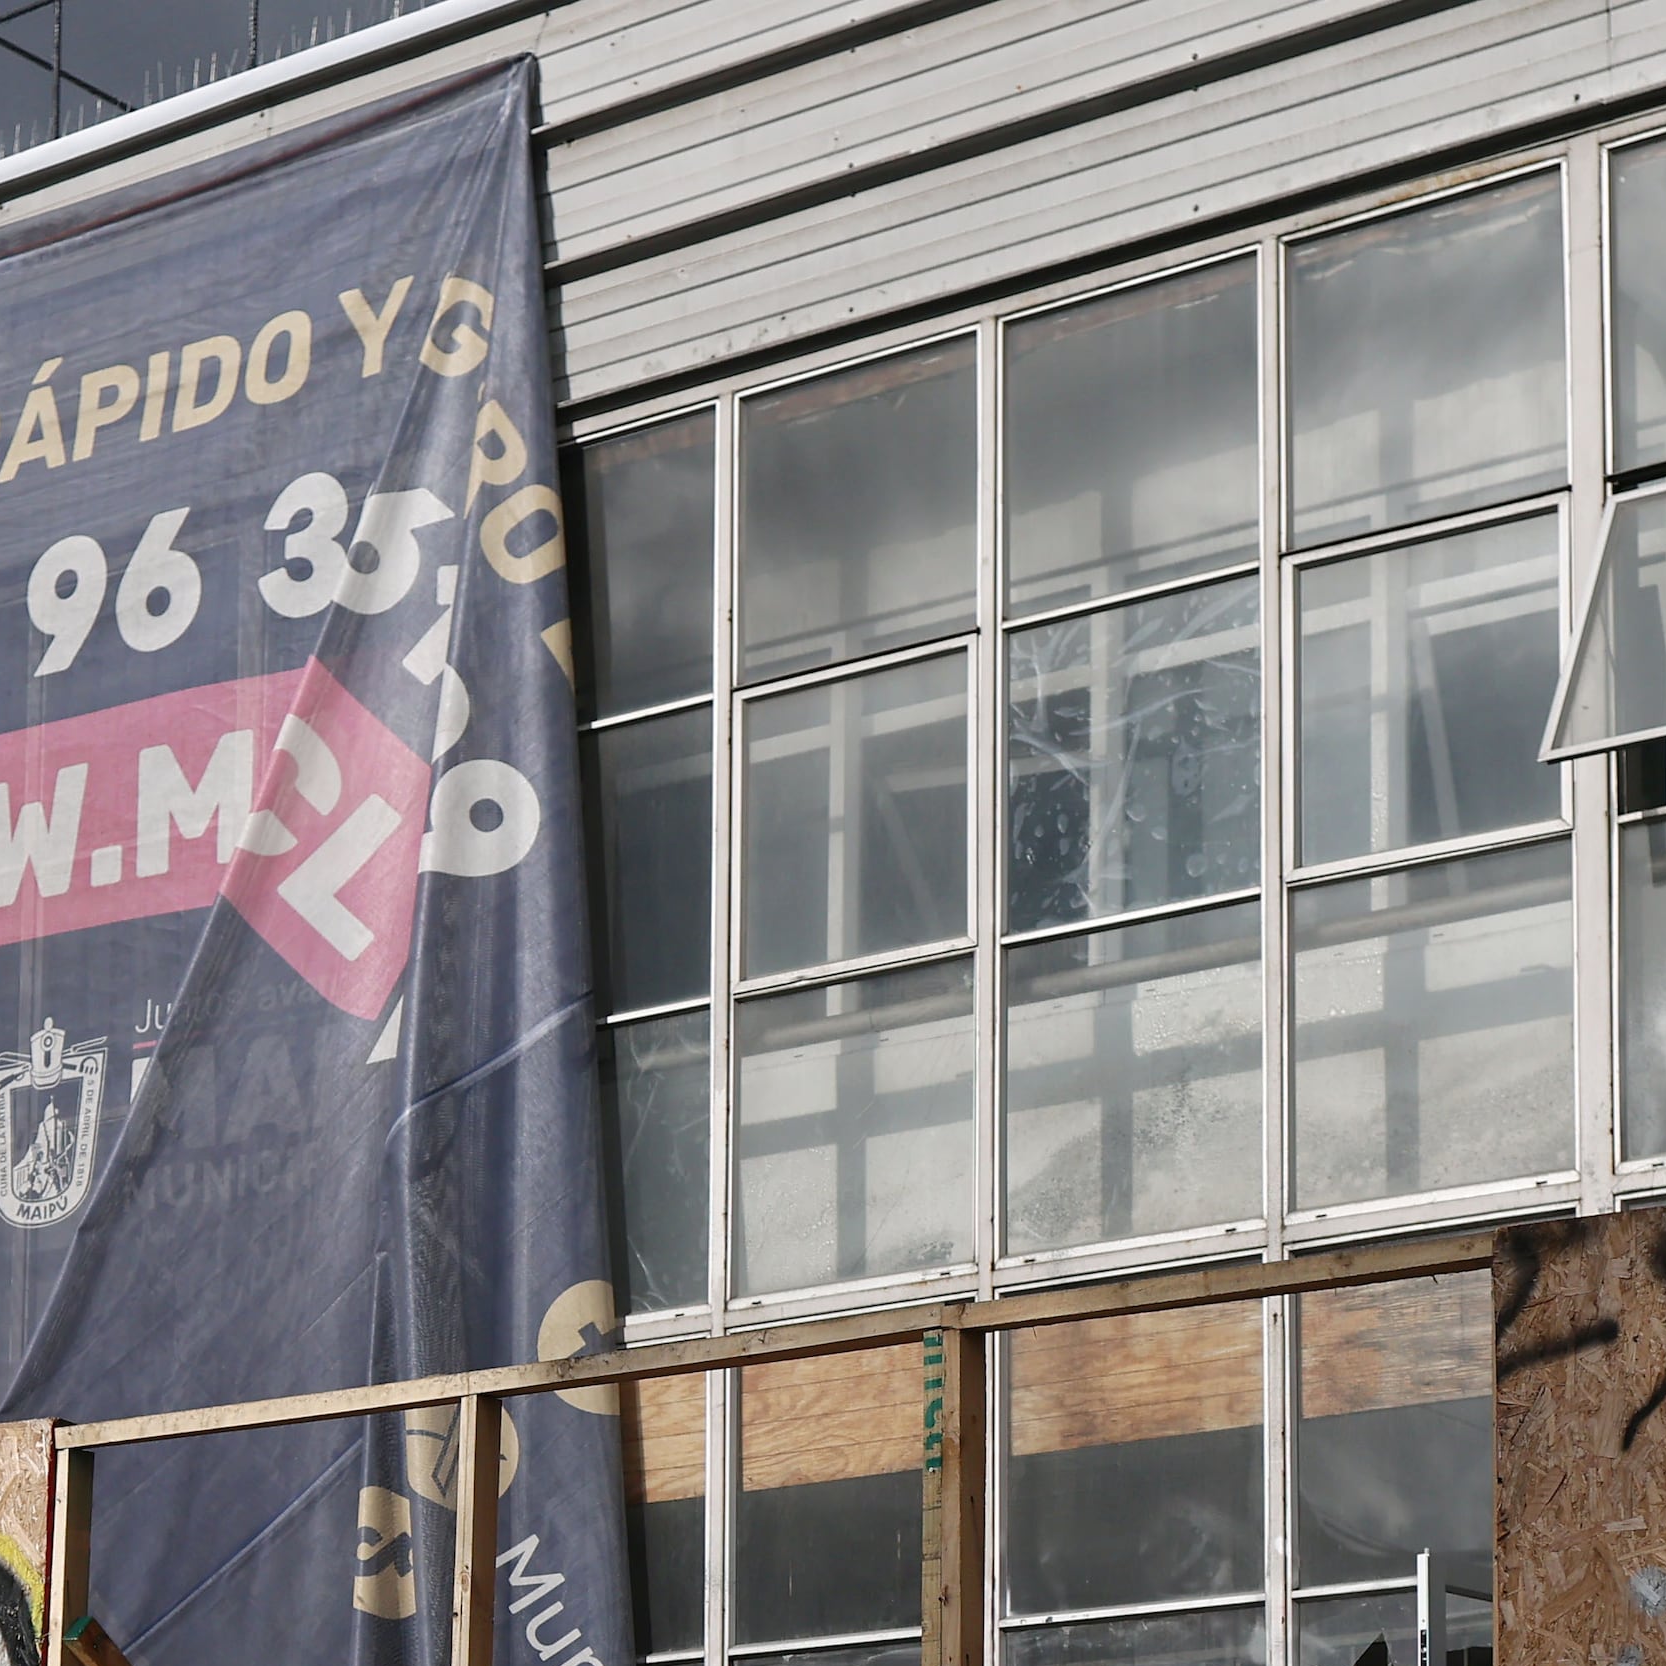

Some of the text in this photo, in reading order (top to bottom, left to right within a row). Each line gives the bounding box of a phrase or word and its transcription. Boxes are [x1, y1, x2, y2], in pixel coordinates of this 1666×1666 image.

[338, 275, 415, 379] Y
[26, 505, 202, 678] 96
[16, 1196, 68, 1220] MAIPÚ
